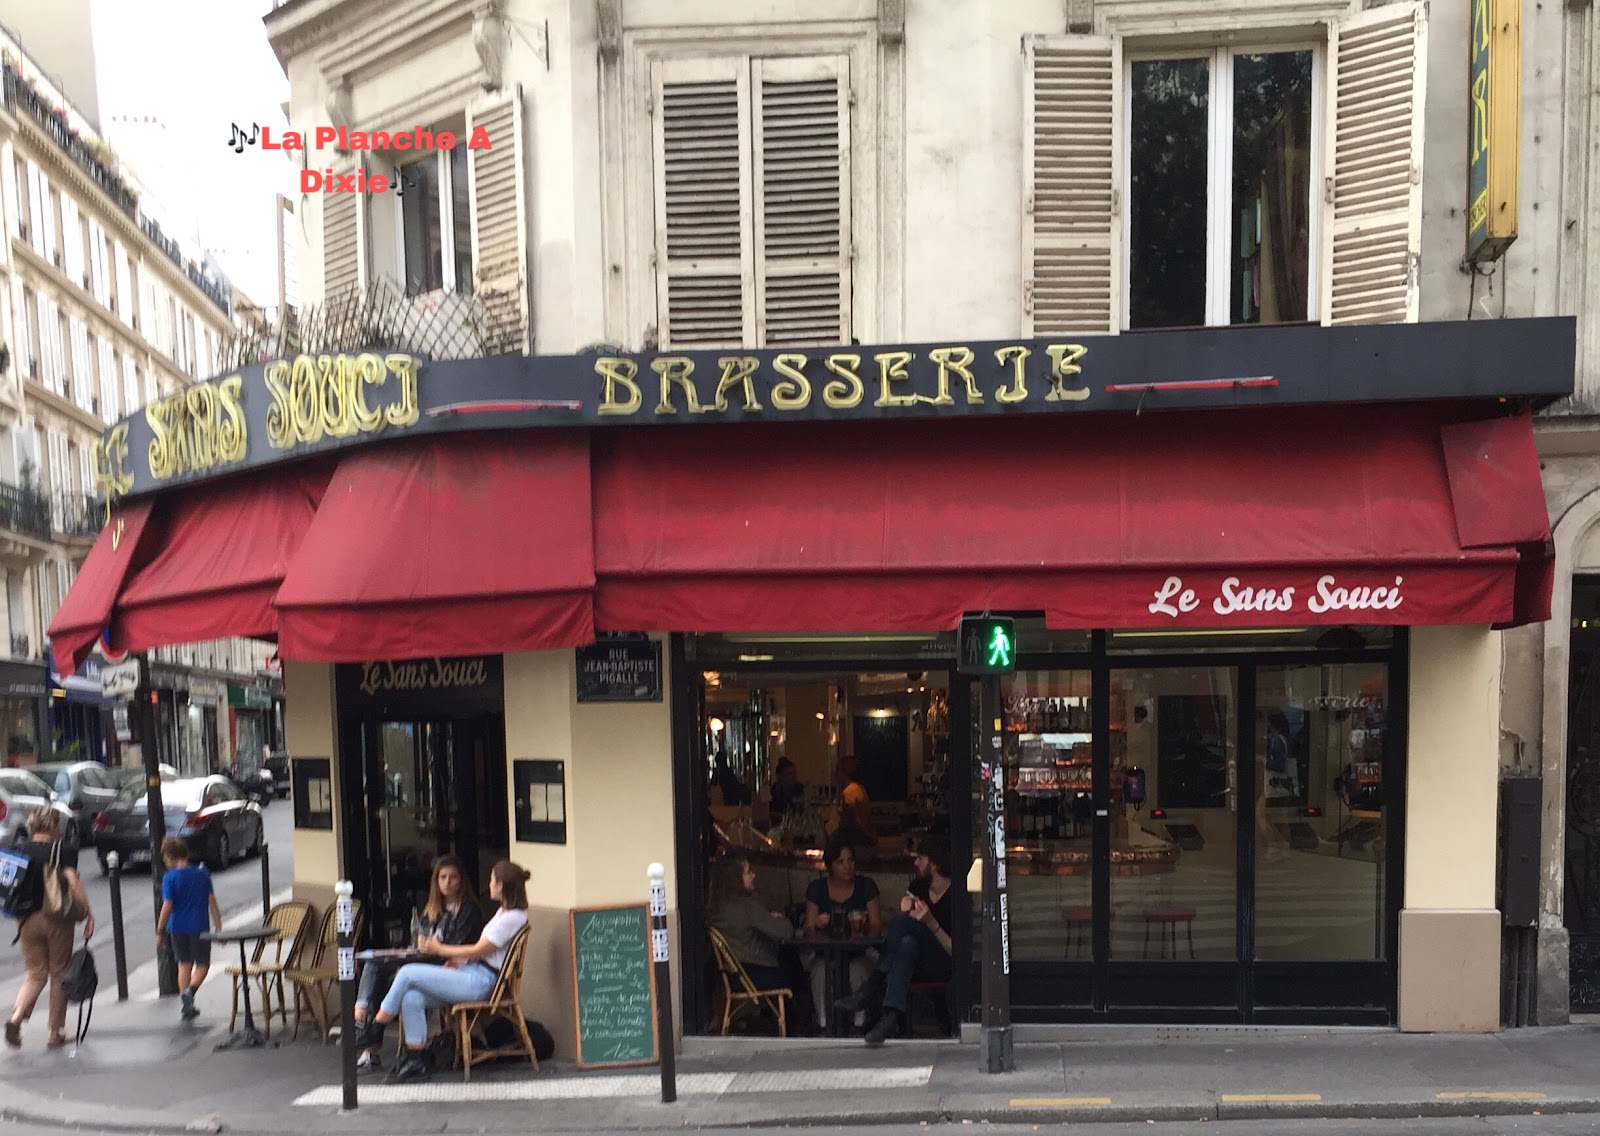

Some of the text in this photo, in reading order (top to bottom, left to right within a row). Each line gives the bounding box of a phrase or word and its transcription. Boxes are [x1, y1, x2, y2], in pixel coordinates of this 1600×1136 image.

[594, 343, 1091, 415] BRASSERIE
[145, 374, 247, 480] SANS
[264, 352, 422, 449] SOUCI
[1148, 575, 1404, 618] Le Sans Souci
[609, 648, 628, 660] RUE
[360, 656, 488, 695] Le Sans Souci
[600, 673, 639, 684] PIGALLE
